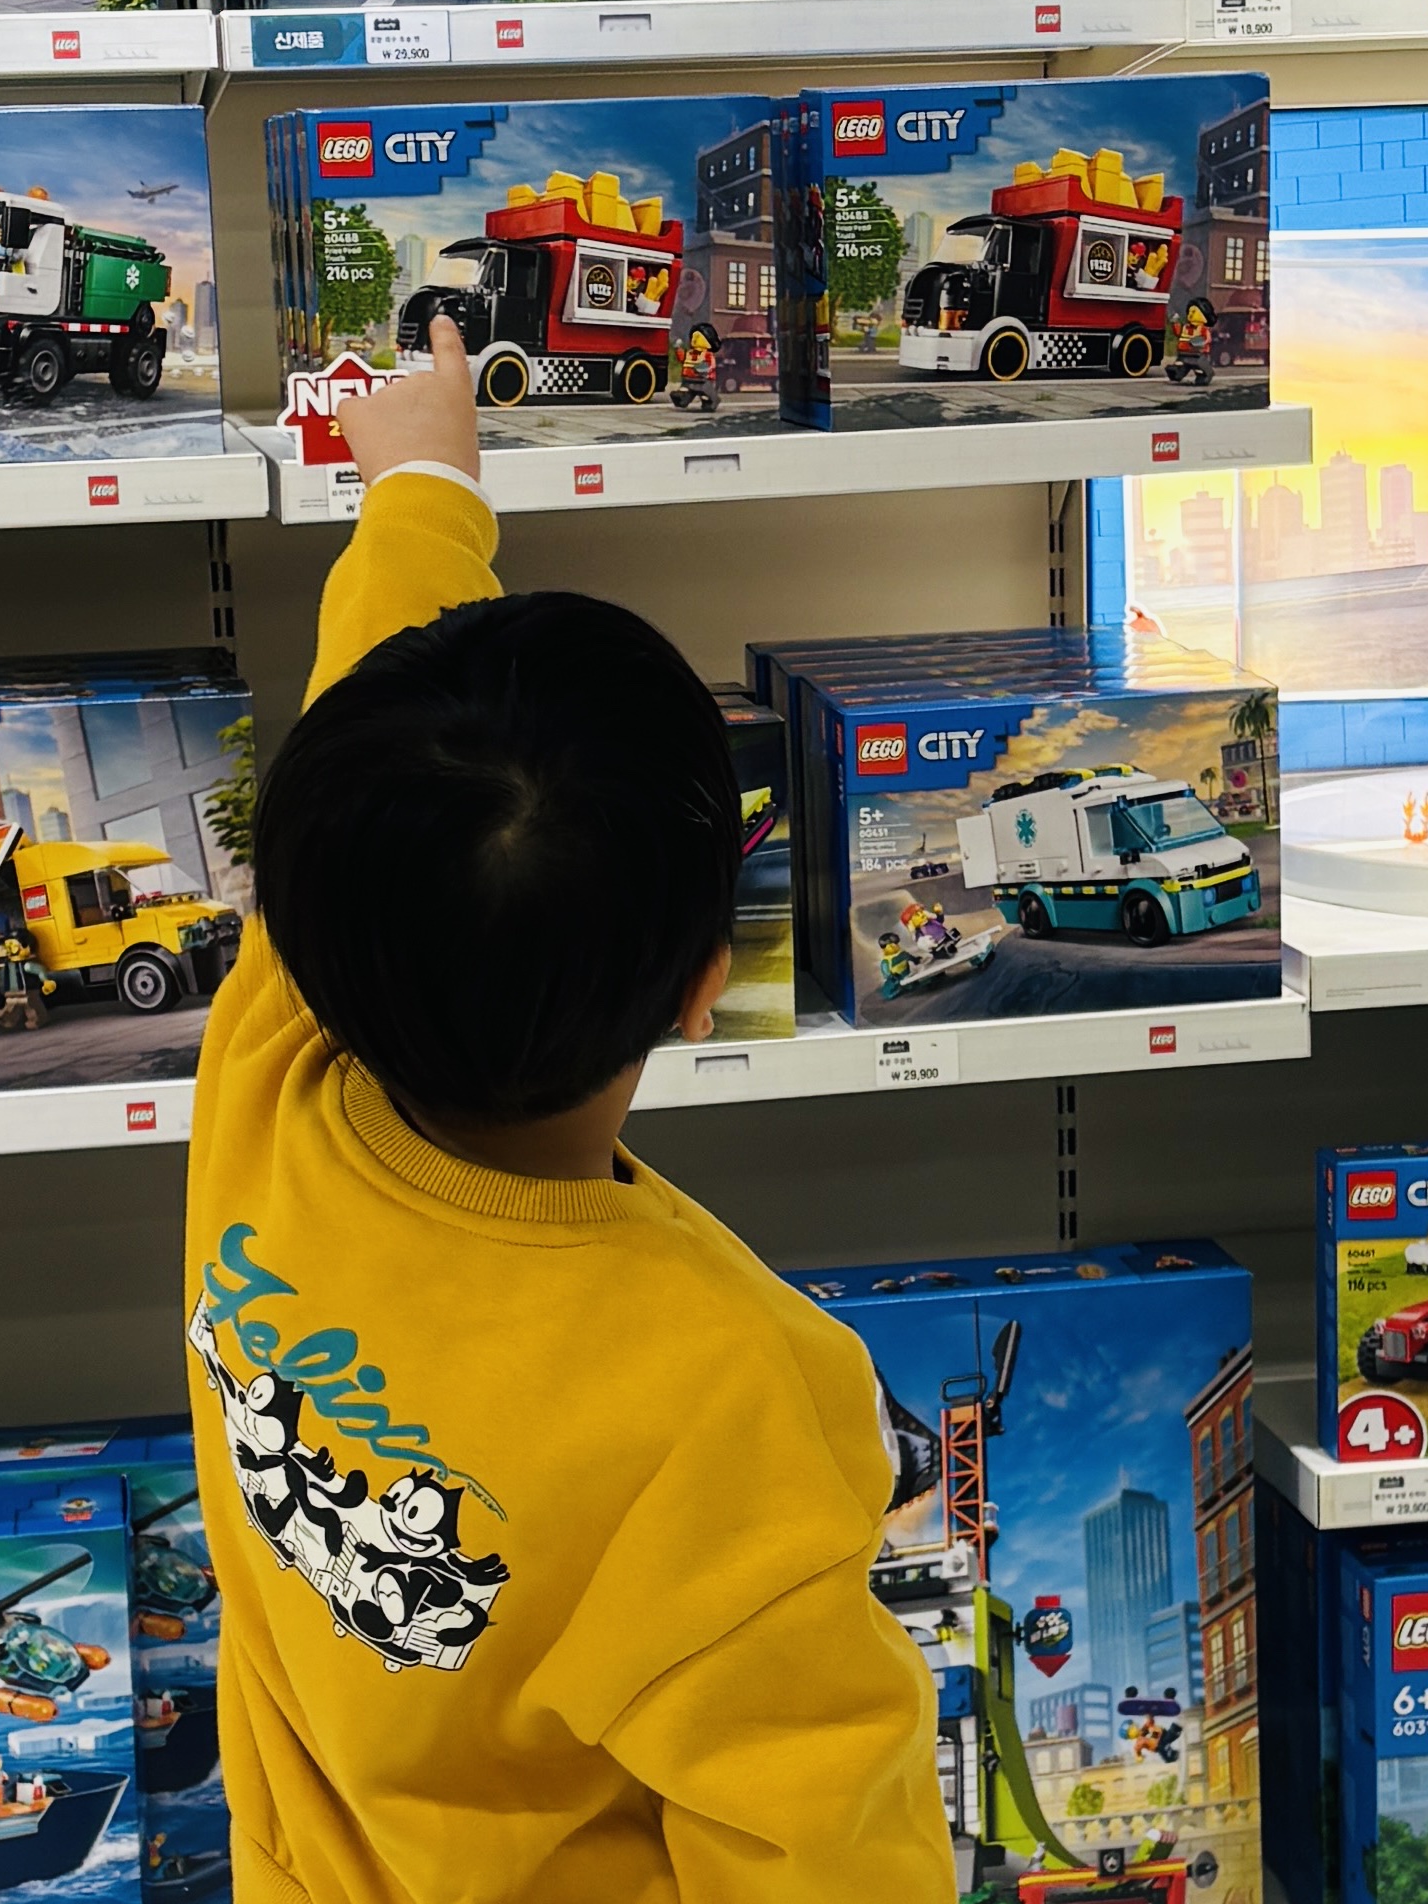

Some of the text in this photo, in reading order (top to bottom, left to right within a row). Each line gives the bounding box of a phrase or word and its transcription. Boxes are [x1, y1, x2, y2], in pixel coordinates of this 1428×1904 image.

[274, 32, 324, 50] 신제품
[836, 188, 860, 207] 5+
[324, 211, 348, 229] 5+
[326, 266, 374, 282] 216 pcs
[859, 808, 884, 825] 5+
[903, 1068, 938, 1081] 29,900
[1347, 1249, 1375, 1258] 60461
[203, 1222, 452, 1484] Felix
[1348, 1408, 1416, 1452] 4+
